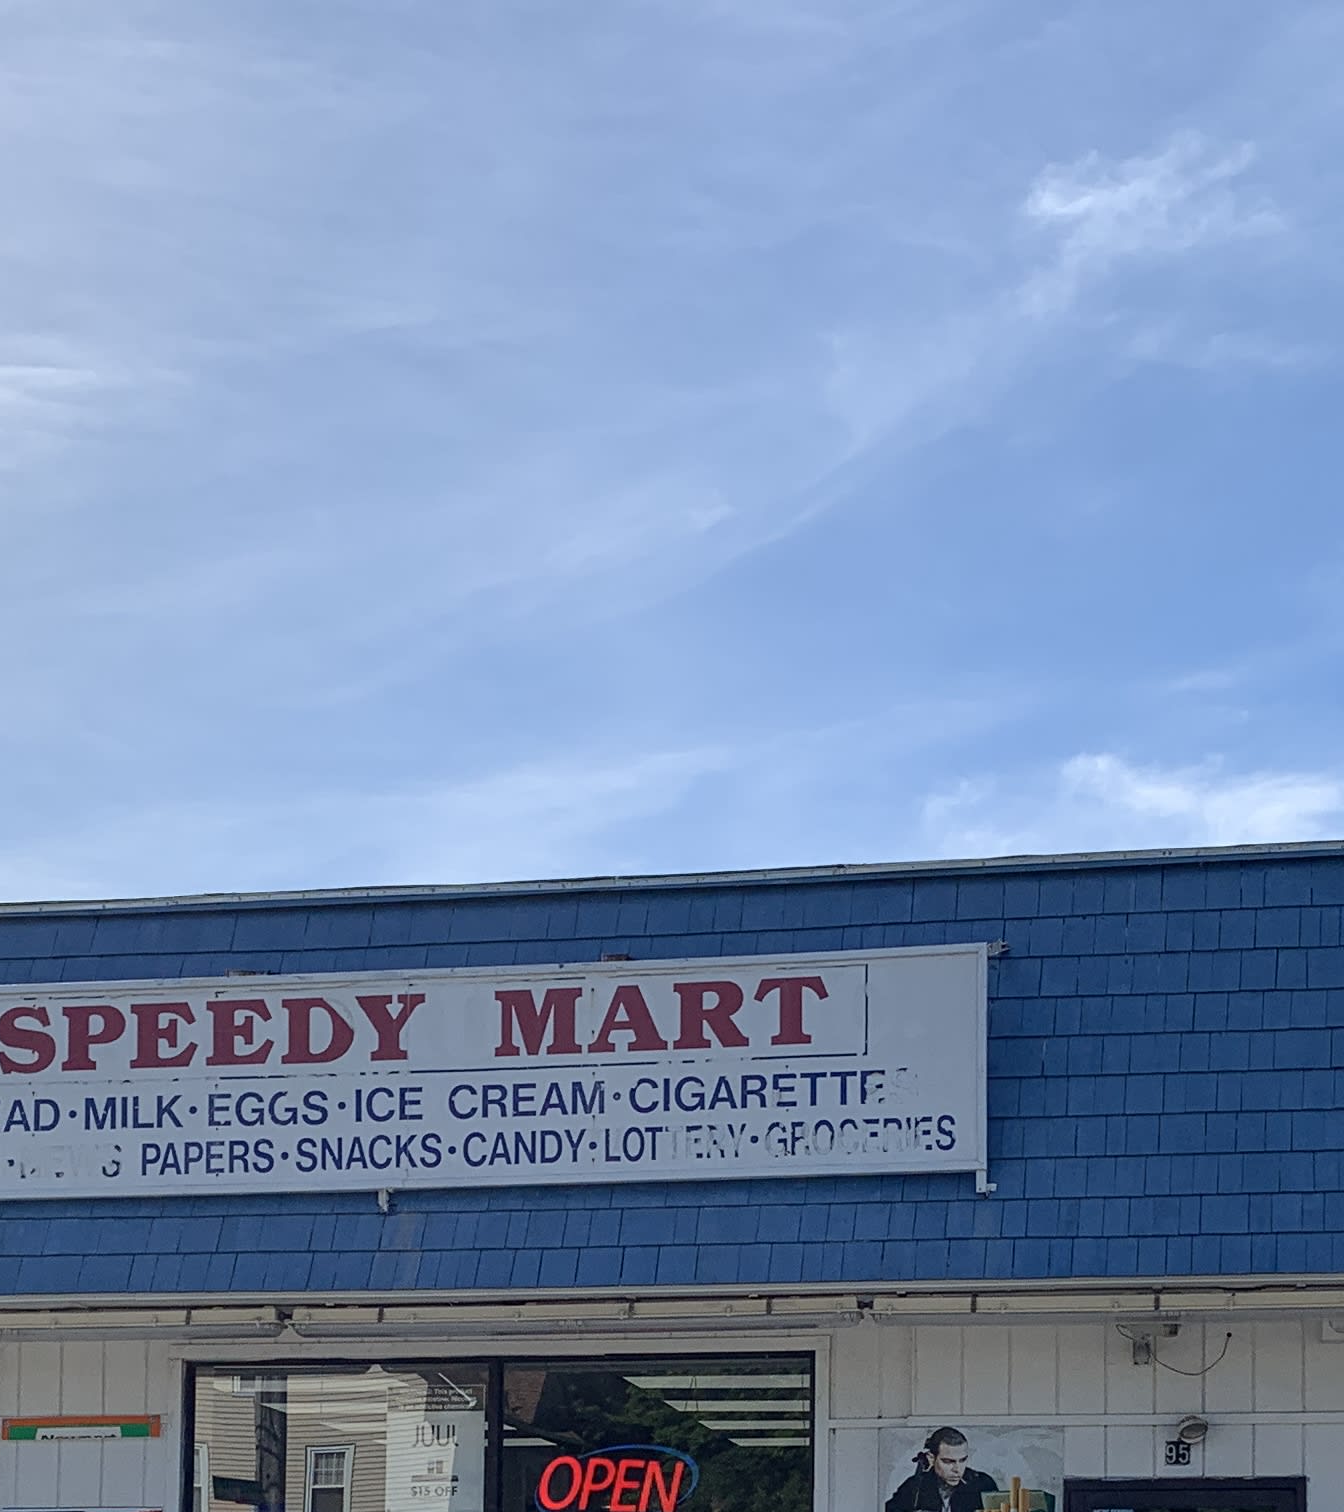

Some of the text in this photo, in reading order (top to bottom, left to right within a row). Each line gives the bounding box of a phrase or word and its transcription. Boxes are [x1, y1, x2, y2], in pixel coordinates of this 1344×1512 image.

[494, 975, 829, 1057] MART
[84, 1094, 184, 1131] MILK
[208, 1090, 328, 1128] EGGS
[355, 1087, 424, 1123] ICE
[448, 1081, 606, 1120] CREAM
[629, 1067, 918, 1114] CIGARETTE
[141, 1138, 275, 1177] PAPERS
[295, 1133, 442, 1171] SNACKS
[462, 1128, 587, 1168] CANDY
[412, 1424, 459, 1447] JUUL
[1166, 1444, 1190, 1465] 95
[435, 1485, 458, 1496] OFF
